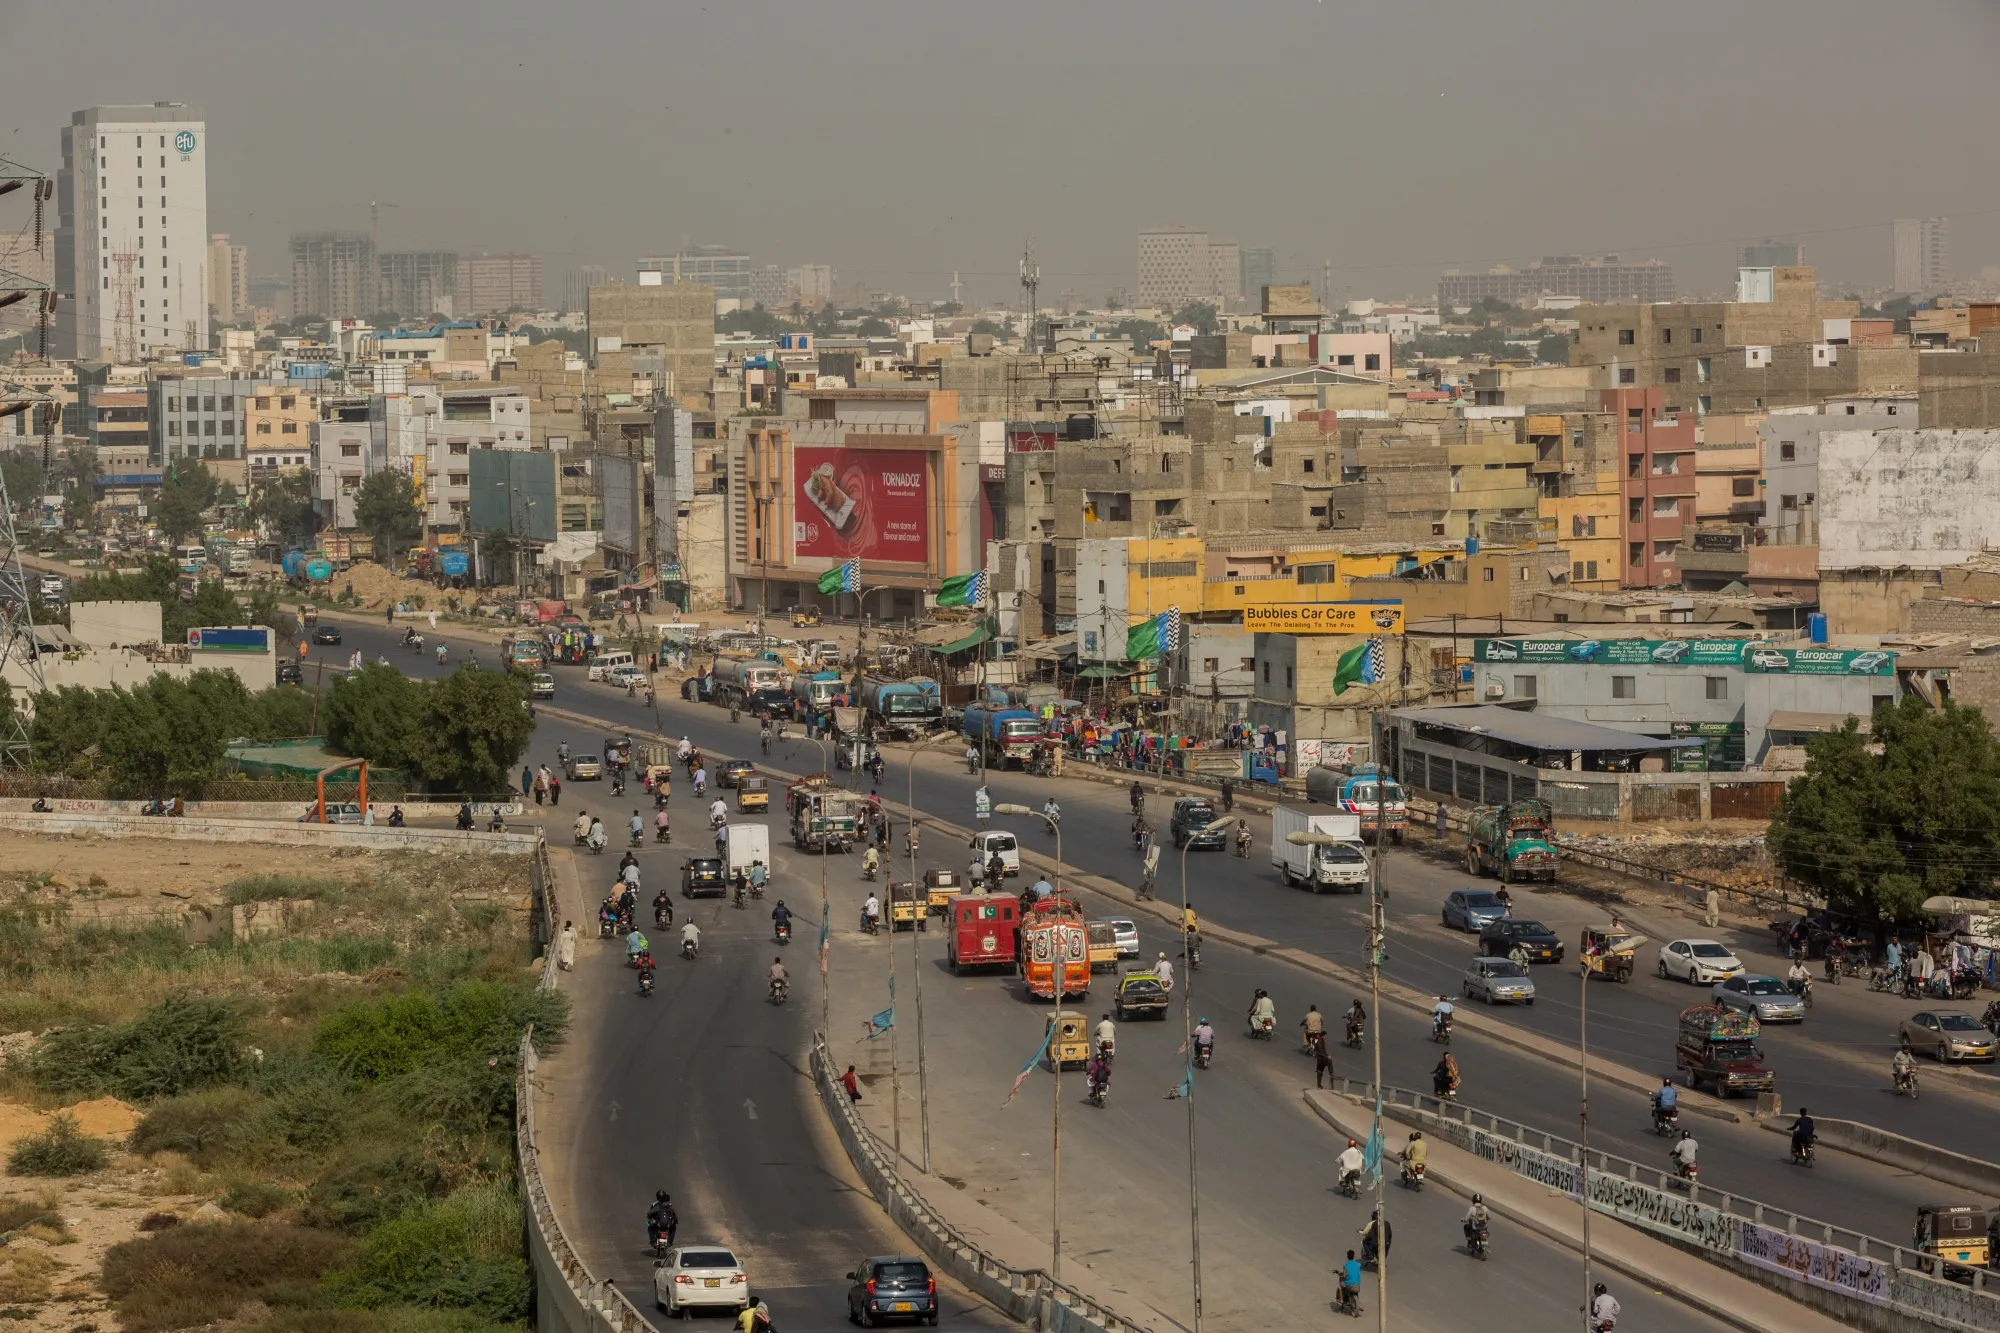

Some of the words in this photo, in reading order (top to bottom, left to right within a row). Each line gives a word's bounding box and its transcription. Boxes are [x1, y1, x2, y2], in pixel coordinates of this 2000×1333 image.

[176, 133, 194, 151] efu
[882, 472, 921, 488] TORNADOZ
[900, 522, 912, 530] storm
[1247, 608, 1298, 619] Bubbles
[1301, 608, 1323, 619] Car
[1326, 608, 1356, 619] Care
[1522, 640, 1565, 653] Europcar
[1694, 642, 1738, 653] Europcar
[1795, 650, 1844, 661] Europcar
[60, 800, 96, 811] NELSON
